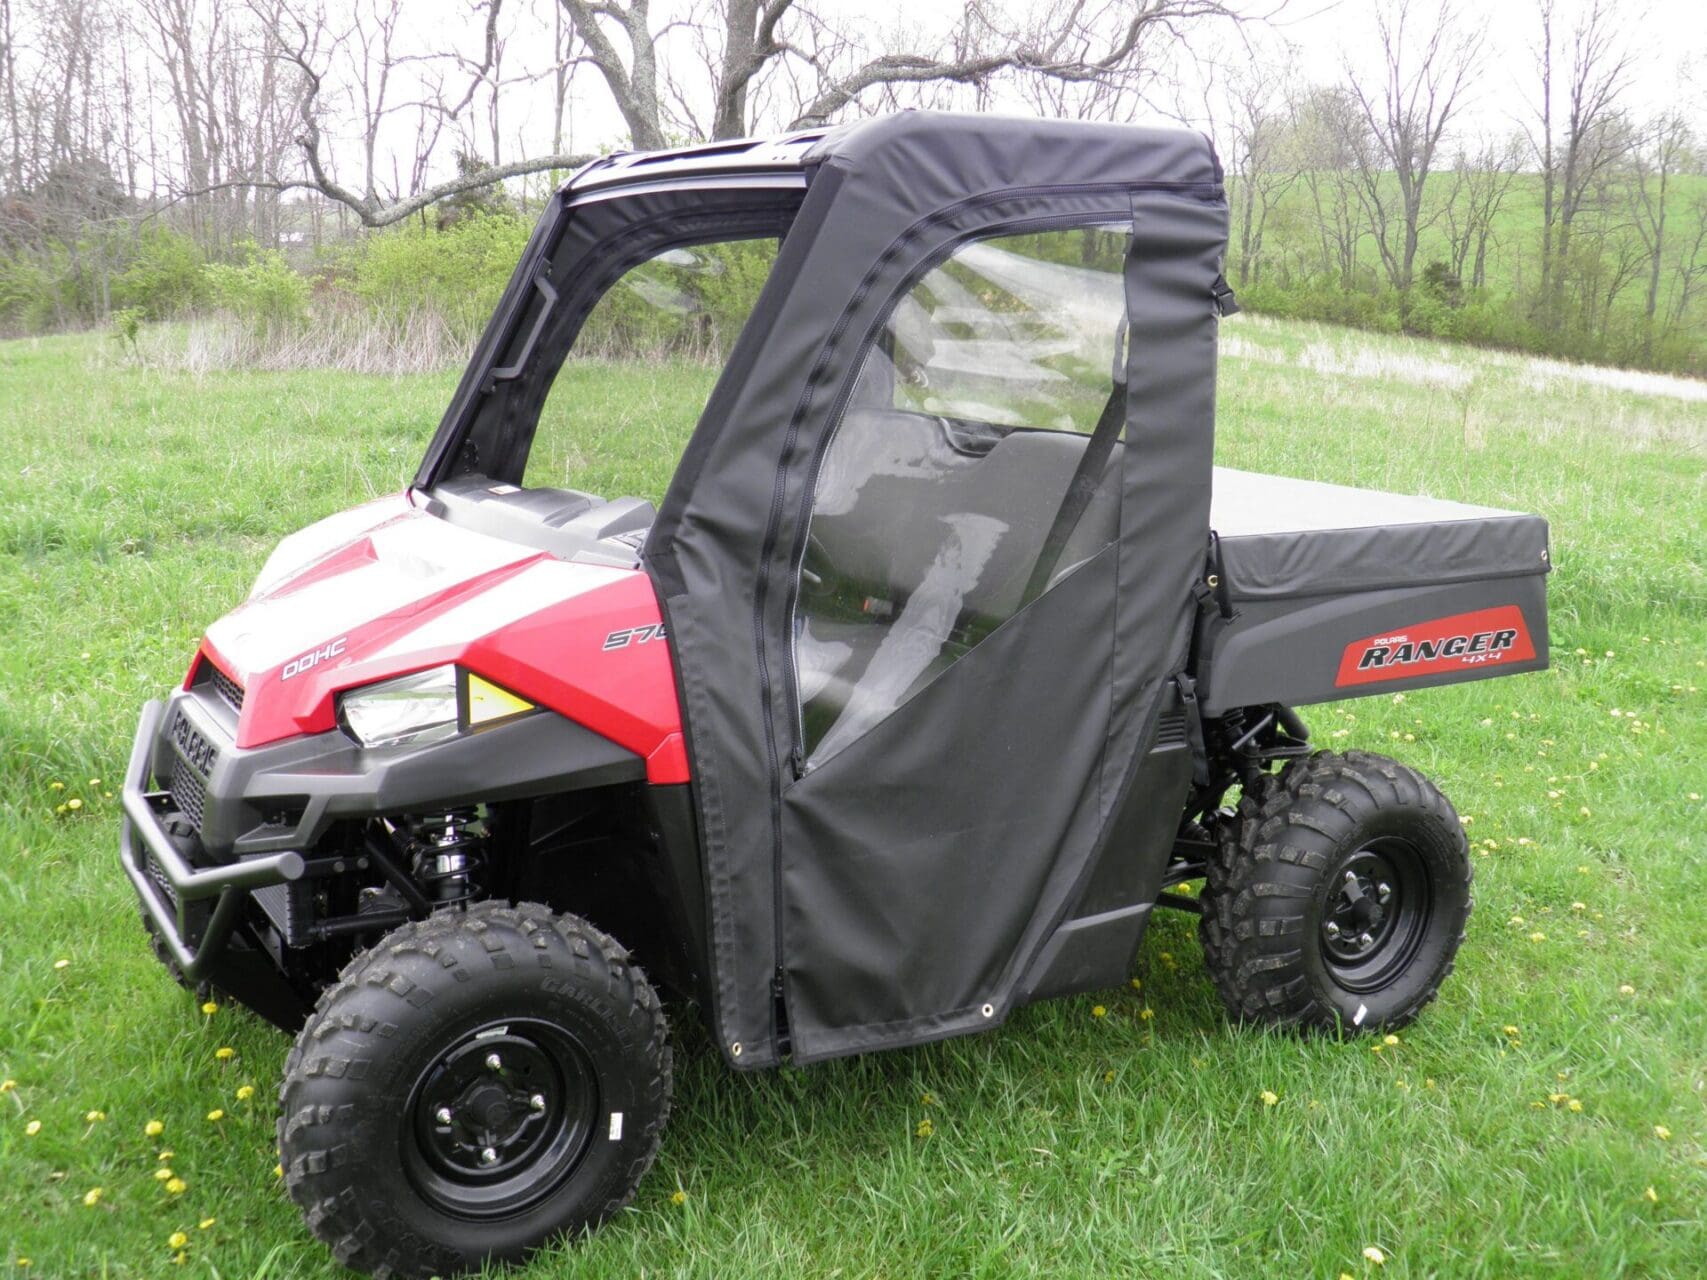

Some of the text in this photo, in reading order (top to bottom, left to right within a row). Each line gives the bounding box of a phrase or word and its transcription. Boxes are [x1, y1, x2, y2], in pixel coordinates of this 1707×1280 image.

[1358, 629, 1517, 669] RANGER
[1374, 635, 1407, 646] POLARIS
[173, 710, 217, 776] POLARIS
